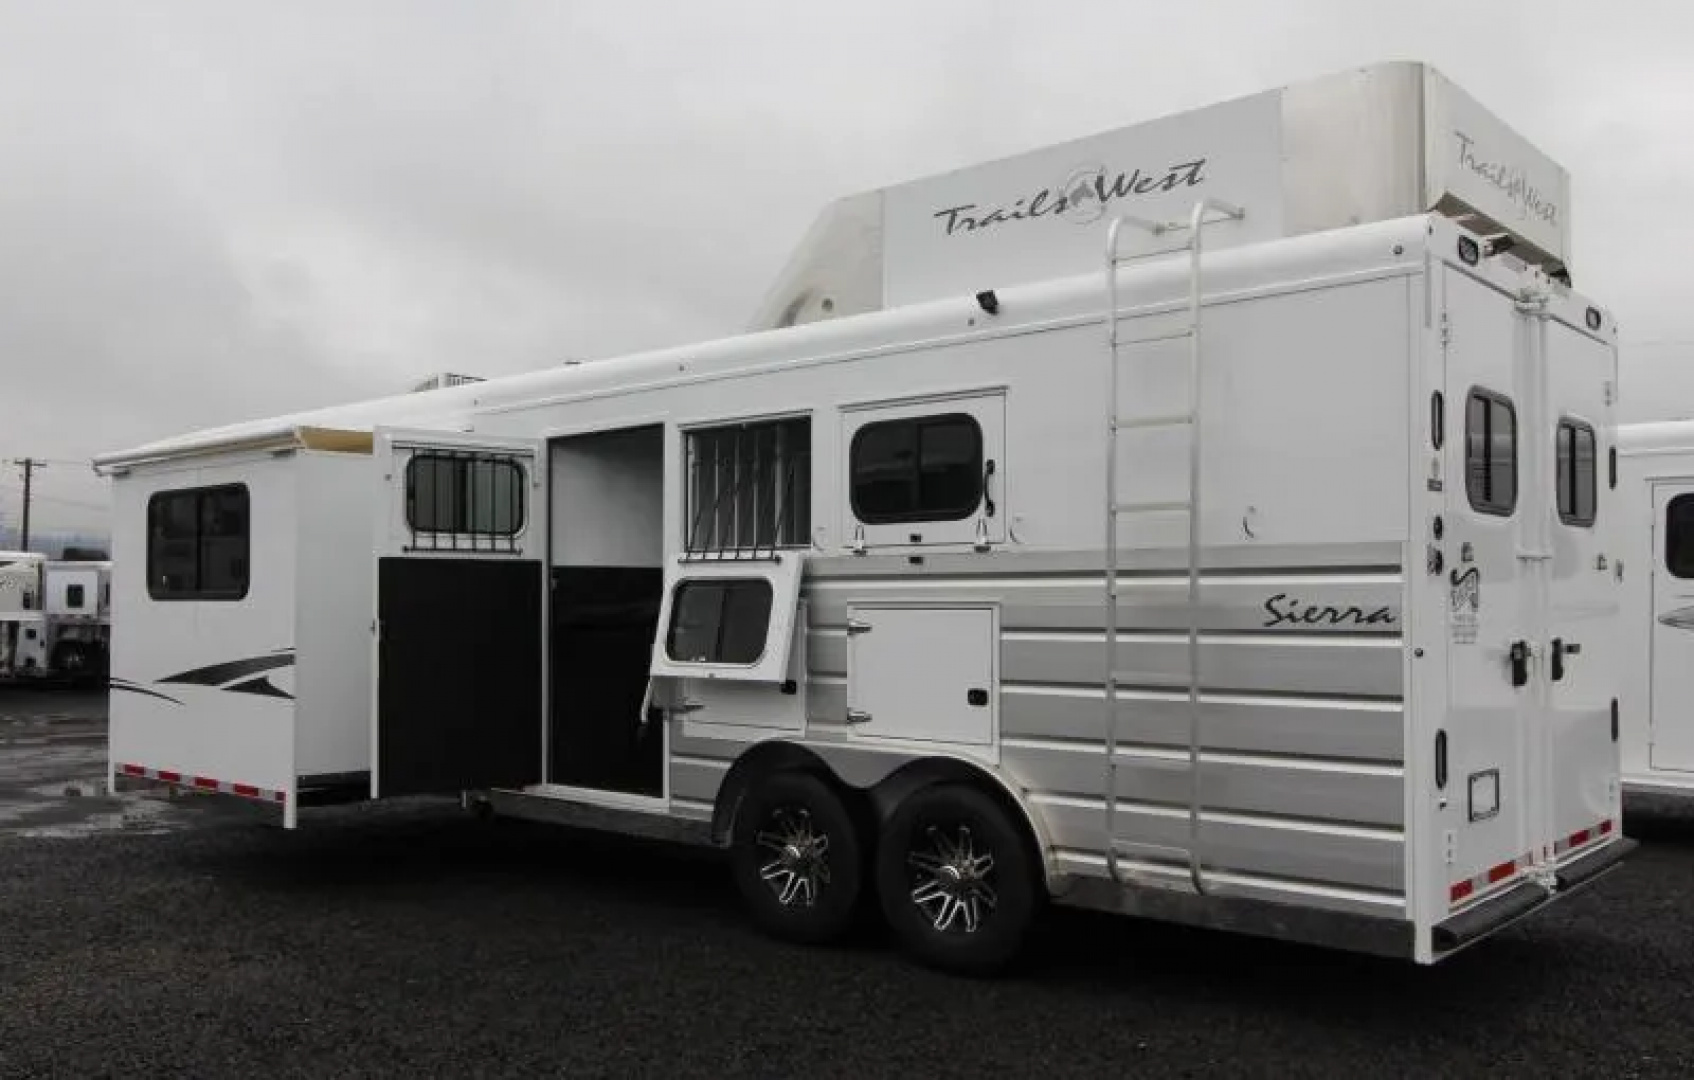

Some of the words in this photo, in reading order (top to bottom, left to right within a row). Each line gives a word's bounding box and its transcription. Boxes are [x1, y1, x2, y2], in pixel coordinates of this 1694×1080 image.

[933, 189, 1069, 236] Trails
[1094, 158, 1206, 203] West
[1263, 593, 1397, 628] Sierra
